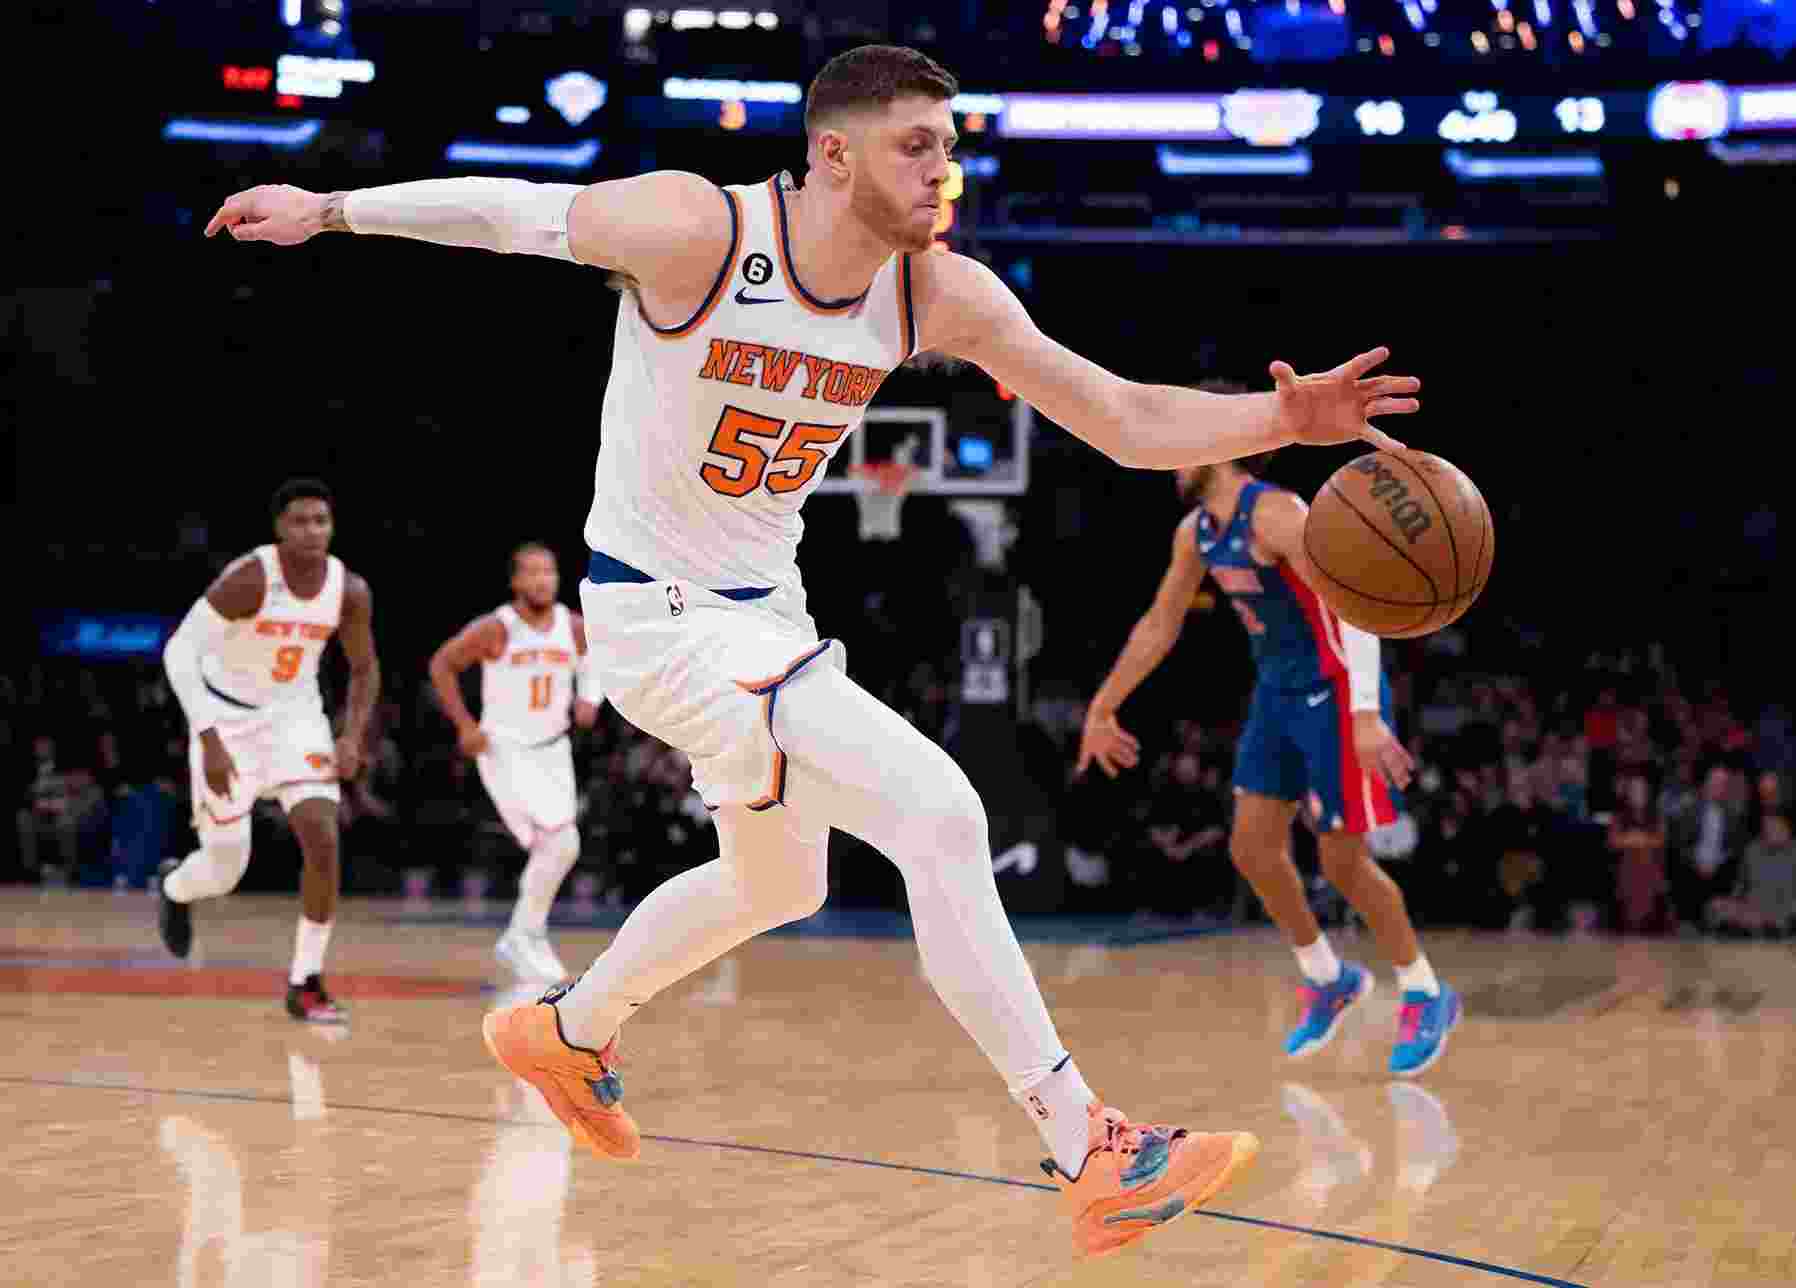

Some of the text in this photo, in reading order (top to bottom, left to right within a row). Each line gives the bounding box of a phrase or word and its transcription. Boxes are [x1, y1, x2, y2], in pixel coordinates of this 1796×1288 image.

[747, 256, 769, 281] 6
[698, 338, 801, 393] NEW
[700, 404, 849, 498] 55
[271, 646, 304, 684] 9
[528, 673, 553, 712] 11
